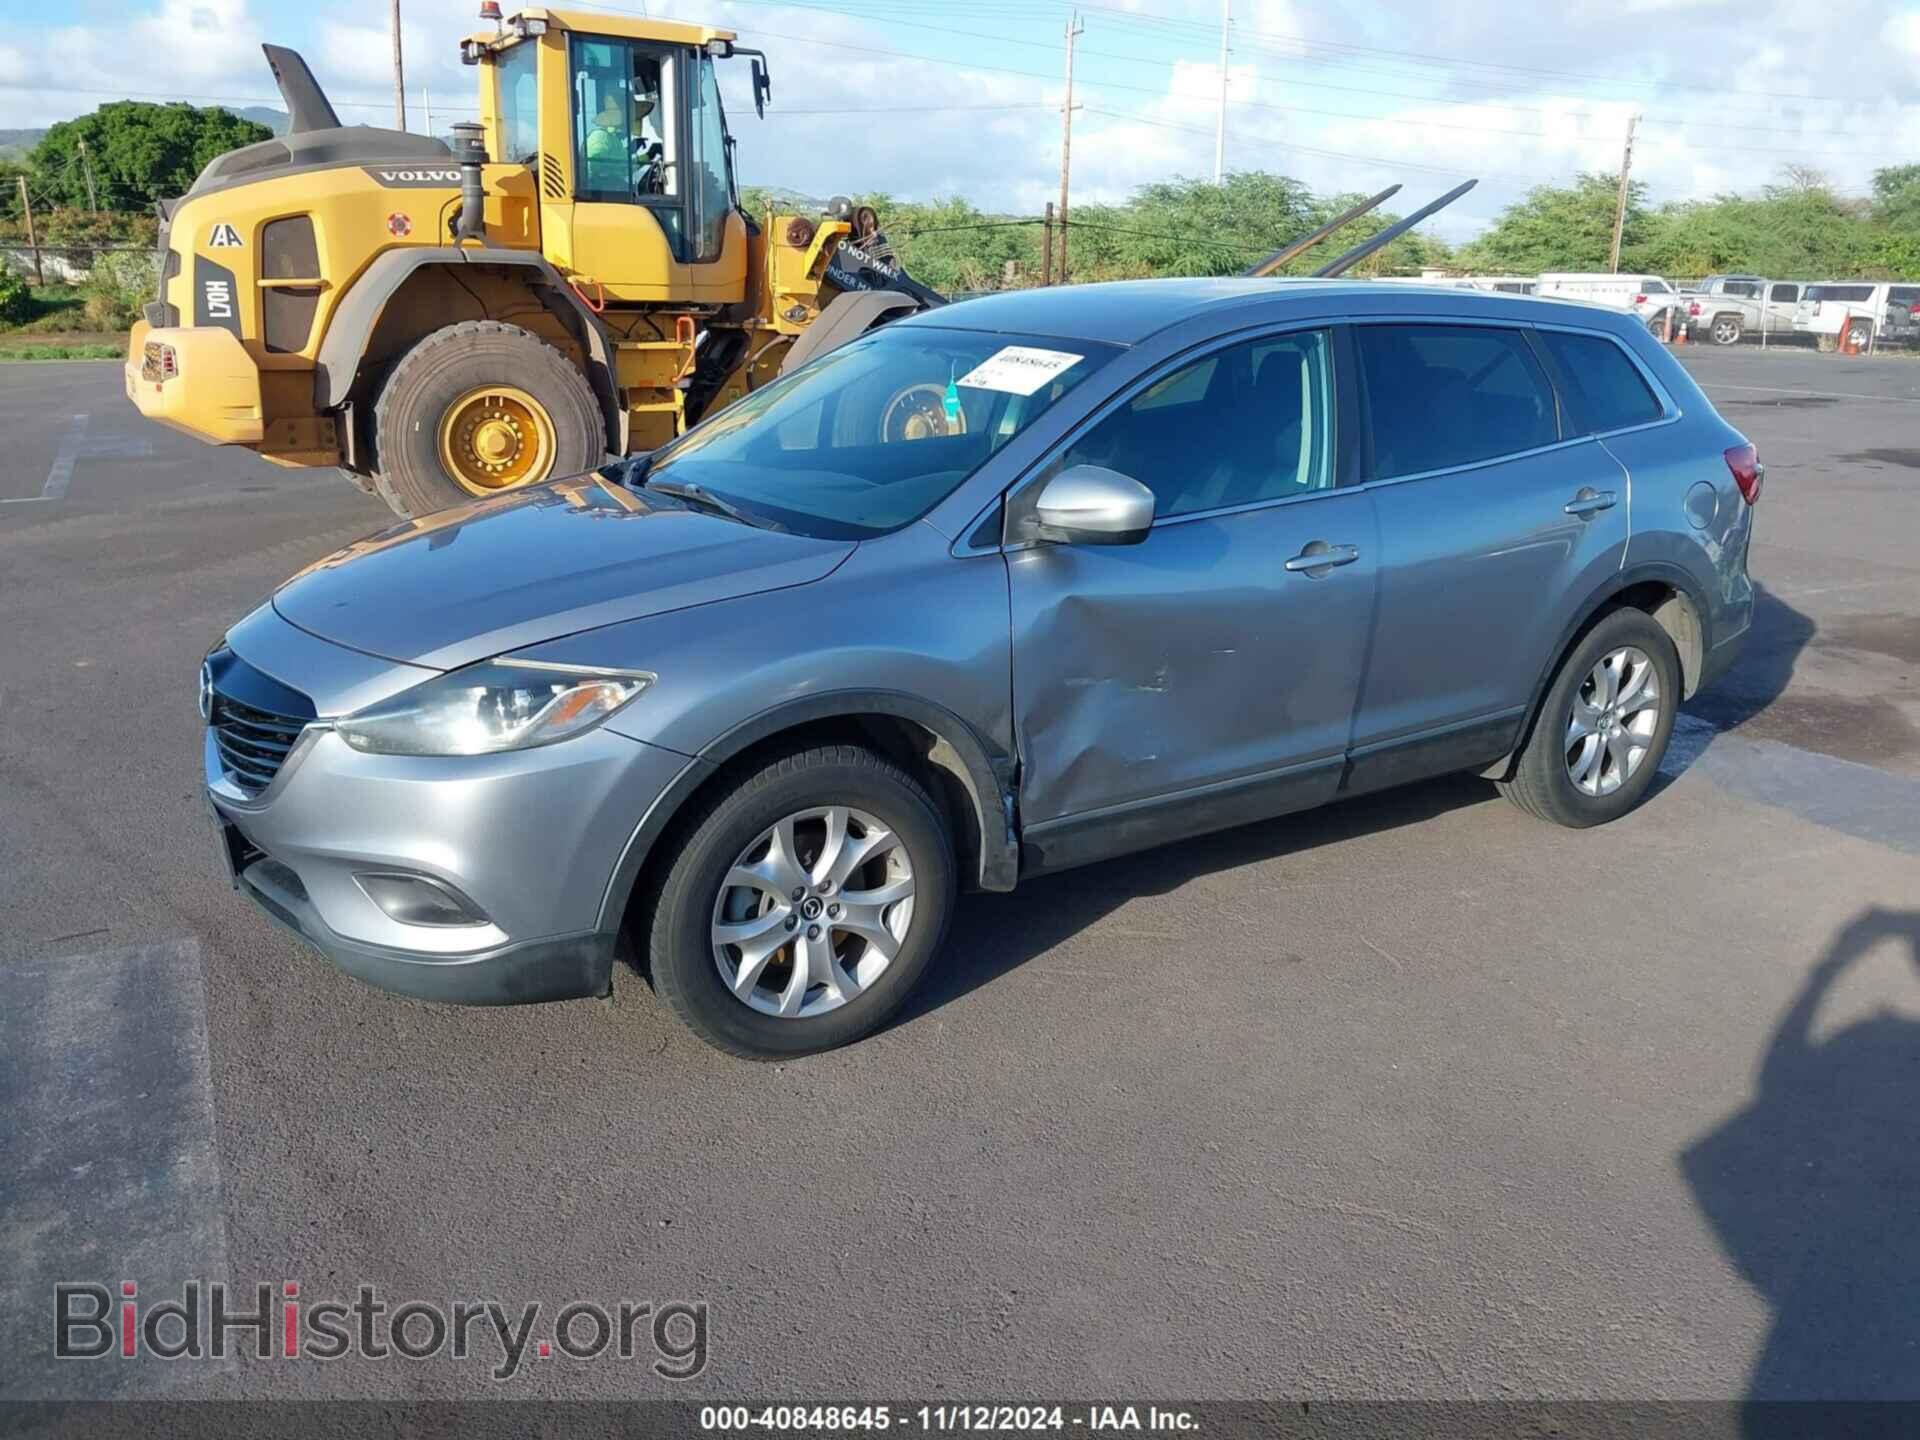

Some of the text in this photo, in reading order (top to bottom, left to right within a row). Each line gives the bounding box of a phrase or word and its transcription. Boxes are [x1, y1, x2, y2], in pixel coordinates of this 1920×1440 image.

[381, 170, 462, 181] VOLVO
[848, 246, 871, 264] NOT
[829, 264, 857, 288] NDER
[205, 280, 232, 318] L70H
